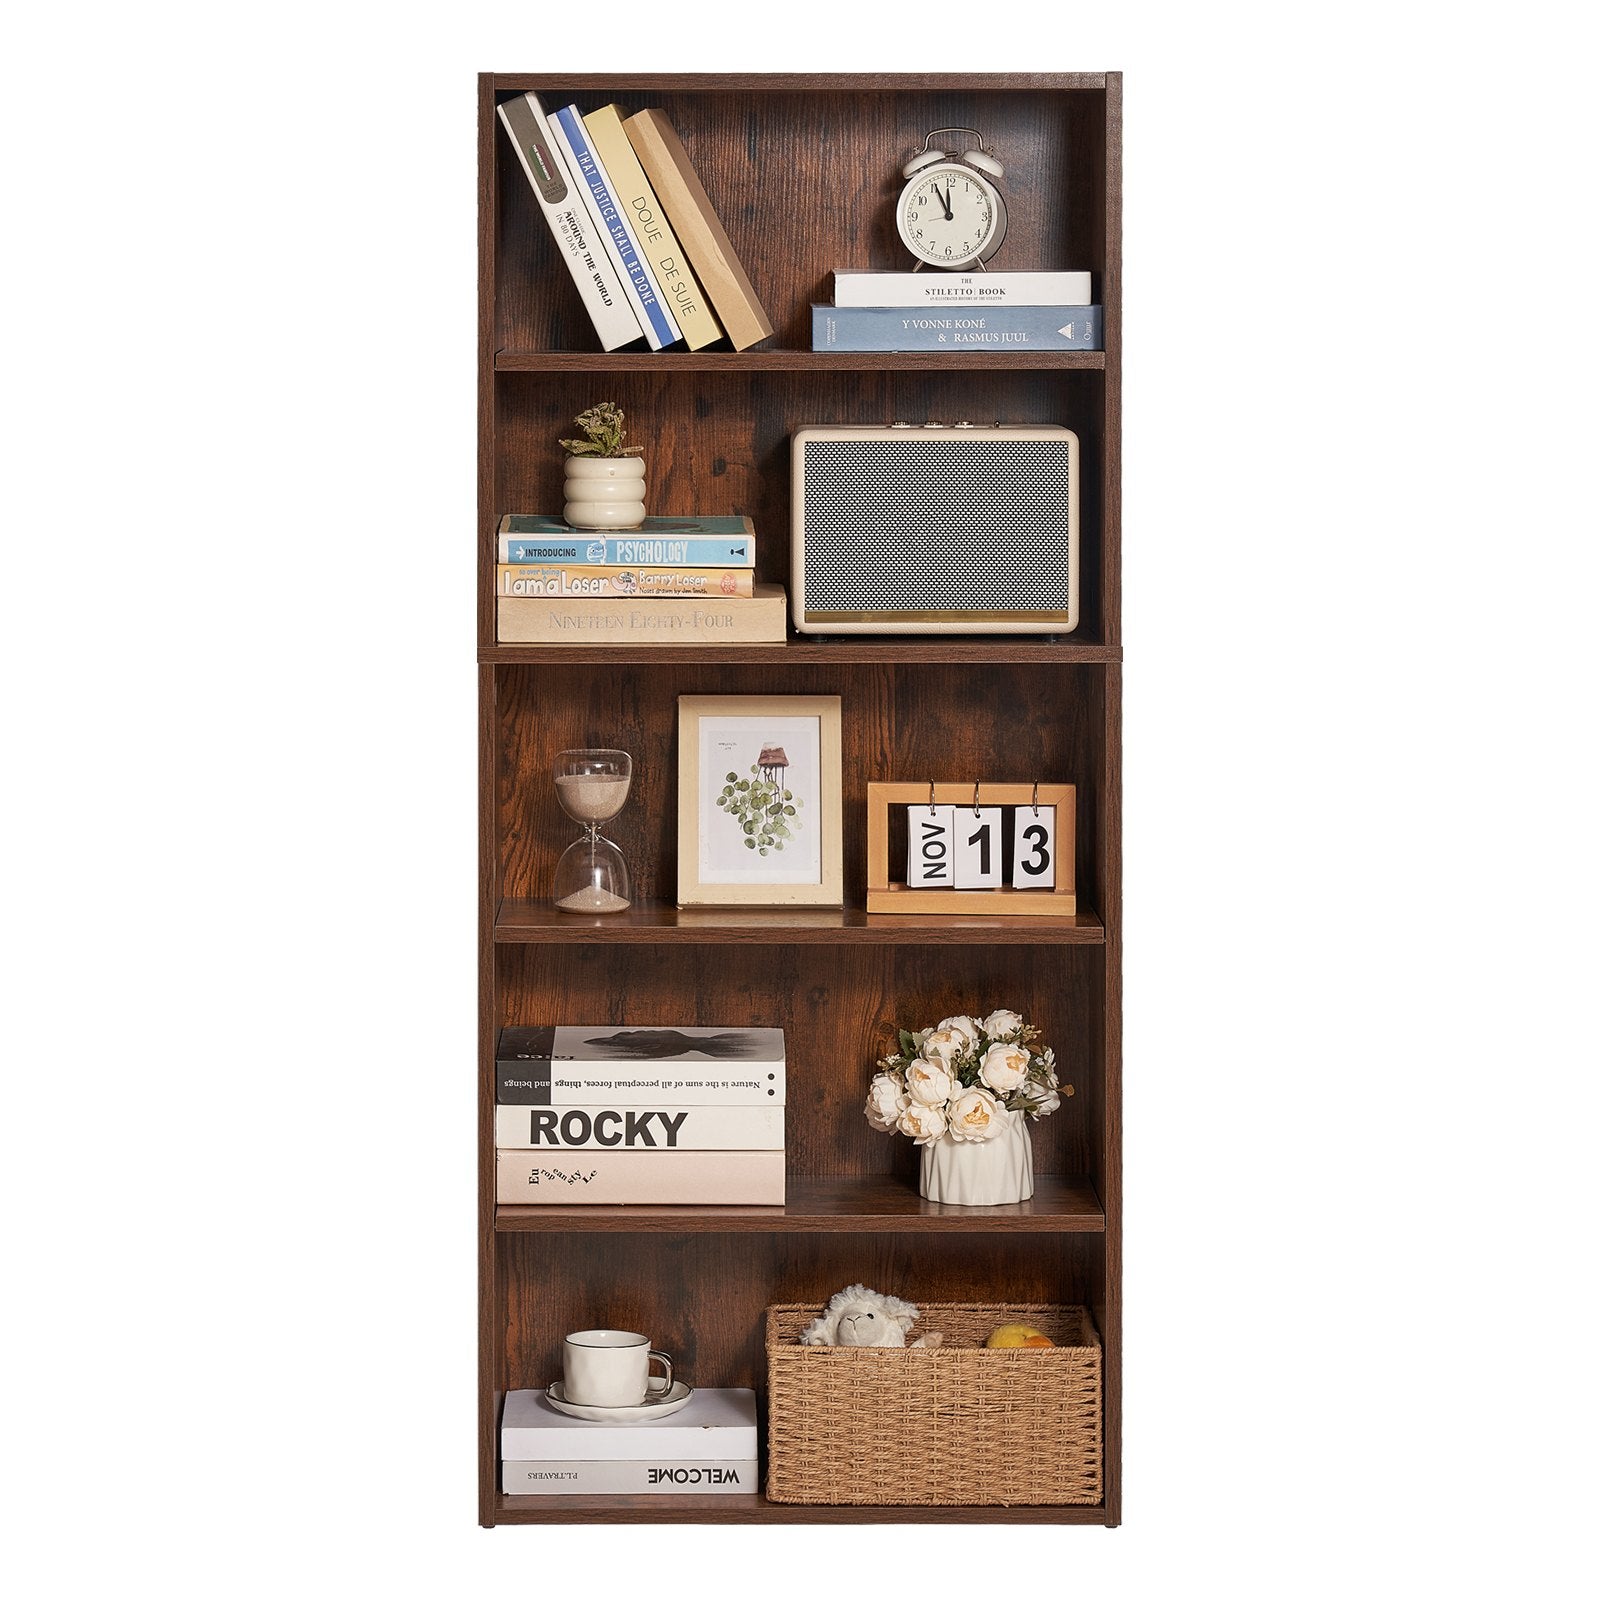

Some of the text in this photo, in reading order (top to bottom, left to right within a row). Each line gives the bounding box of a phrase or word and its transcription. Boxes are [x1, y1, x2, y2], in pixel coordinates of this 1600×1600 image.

[946, 177, 956, 187] 12
[965, 182, 969, 192] 1
[918, 196, 928, 205] 10
[976, 195, 983, 204] 2
[911, 212, 918, 221] 9
[981, 212, 988, 221] 3
[577, 150, 656, 306] THAT JUSTICE SHALL BE DONE
[974, 228, 981, 238] 4
[555, 213, 579, 257] IN 80 DAYS
[916, 229, 923, 239] 8
[930, 241, 936, 251] 7
[945, 246, 952, 256] 6
[963, 242, 970, 251] 5
[563, 210, 613, 308] AROUND THE WORLD
[631, 196, 697, 317] DOUE DE SUIE
[924, 288, 1006, 296] STILETTO BOOK
[954, 317, 987, 329] KONÉ
[937, 332, 1029, 344] & RASMUS JUUL
[525, 547, 577, 558] INTRODUCING
[616, 540, 689, 563] PSYCHOLOGY
[504, 570, 609, 595] I am a Loser
[639, 569, 675, 586] Barry
[676, 573, 708, 586] Loser
[922, 822, 1051, 879] NOV 1 3
[504, 1079, 760, 1089] Nature is the sum of all perceptual forces, things and beings
[530, 1109, 688, 1147] ROCKY
[648, 1468, 740, 1484] WELCOME
